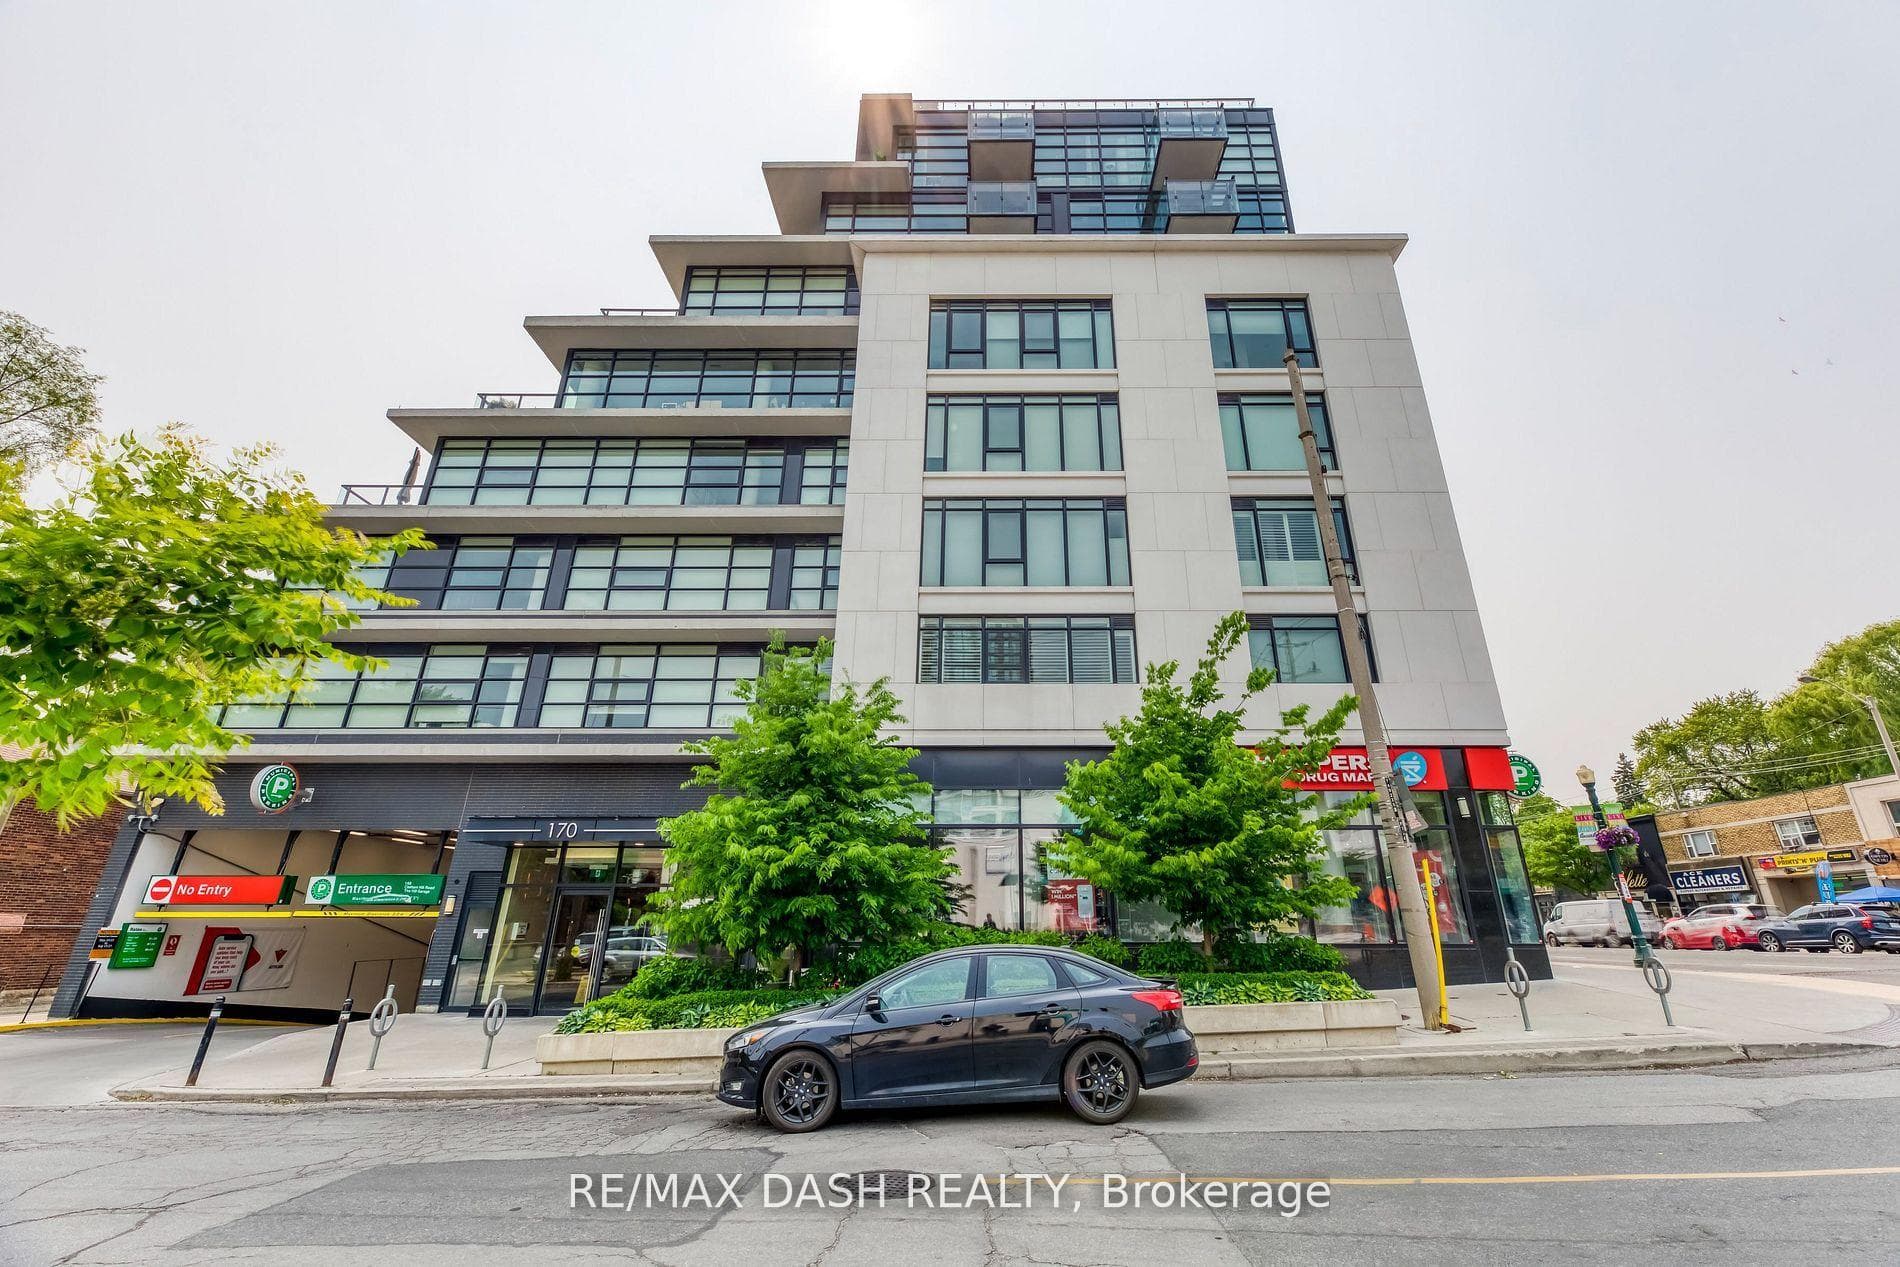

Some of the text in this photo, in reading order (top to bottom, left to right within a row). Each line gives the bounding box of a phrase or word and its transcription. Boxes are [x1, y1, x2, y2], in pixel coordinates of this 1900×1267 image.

[271, 776, 289, 794] P
[1342, 772, 1376, 783] MAR
[549, 822, 578, 838] 170
[1626, 870, 1649, 888] lette
[1676, 872, 1741, 888] CLEANERS
[176, 884, 232, 898] No Entry
[337, 883, 392, 894] Entrance
